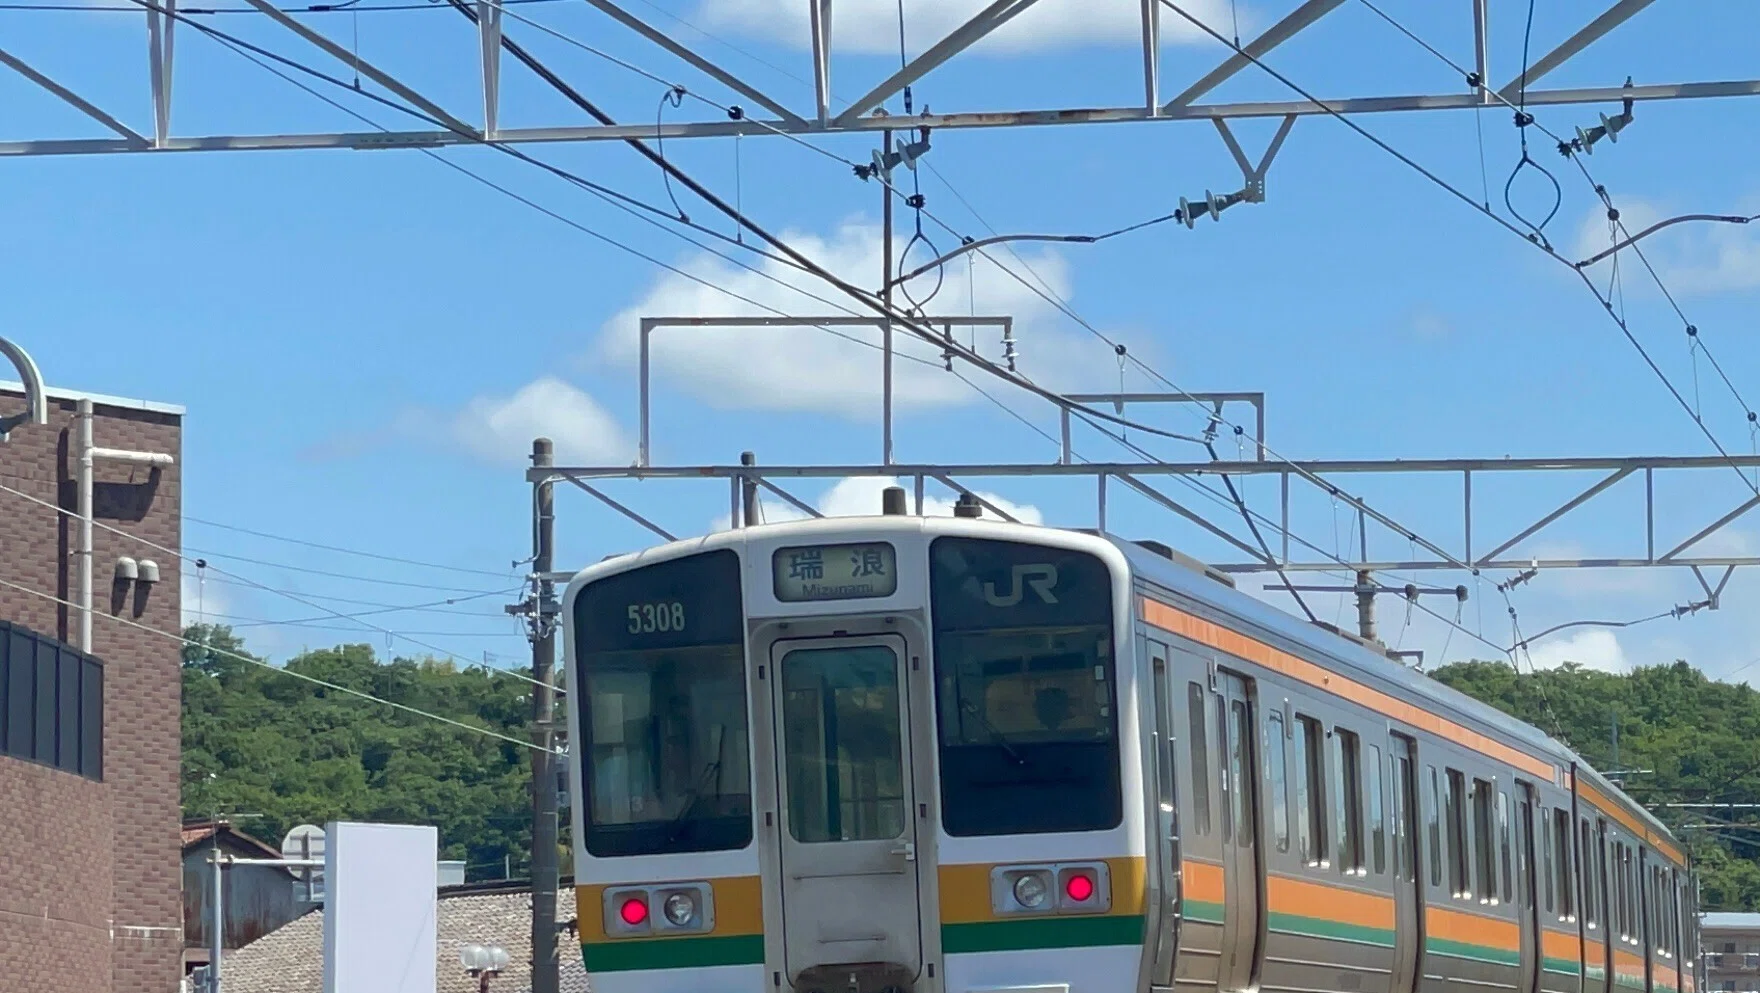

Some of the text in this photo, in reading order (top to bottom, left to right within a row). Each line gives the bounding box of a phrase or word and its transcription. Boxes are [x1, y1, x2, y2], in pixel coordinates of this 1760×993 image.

[802, 583, 874, 597] Mizunami
[983, 563, 1060, 608] JR
[627, 602, 685, 634] 5308
